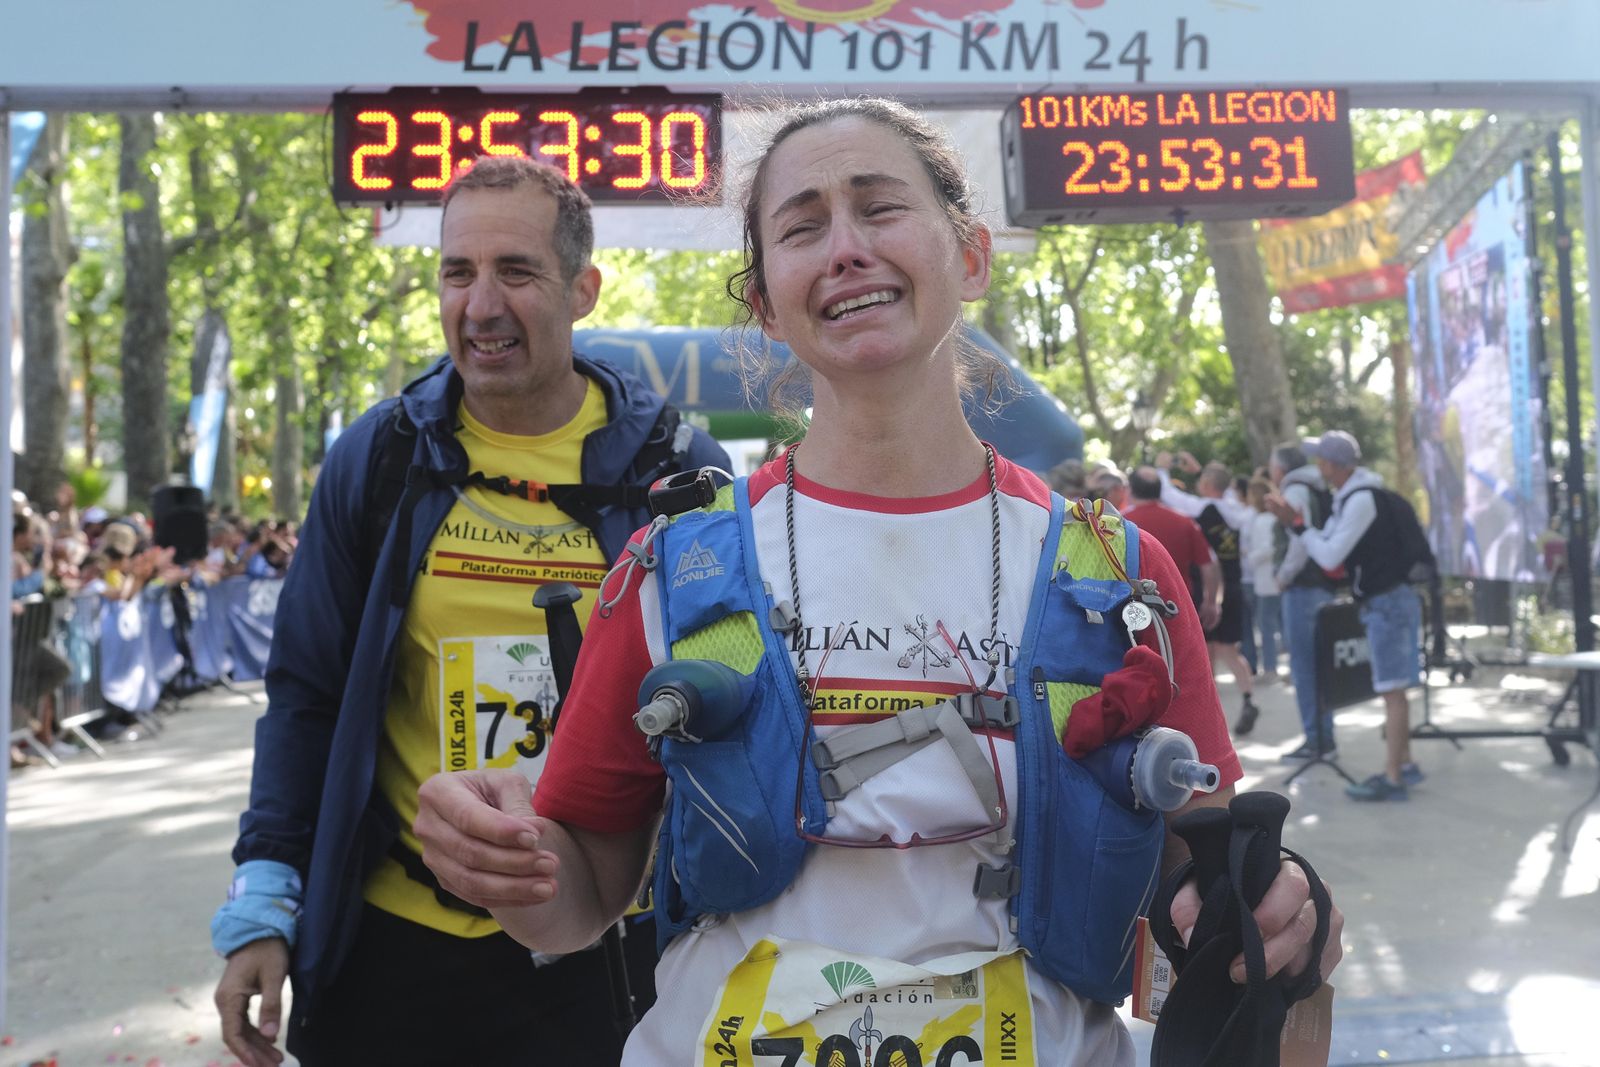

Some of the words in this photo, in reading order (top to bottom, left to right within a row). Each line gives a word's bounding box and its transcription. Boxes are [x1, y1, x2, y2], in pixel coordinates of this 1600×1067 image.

[463, 20, 544, 72] LA
[568, 7, 817, 72] LEGIÓN
[840, 29, 933, 72] 101
[958, 20, 1061, 71] KM
[1083, 29, 1152, 83] 24
[1174, 18, 1209, 71] h
[1020, 95, 1149, 128] 101KMs
[1157, 93, 1200, 125] LA
[1208, 90, 1337, 123] LEGION
[352, 111, 705, 189] 23:53:30
[1063, 136, 1318, 194] 23:53:31
[461, 561, 537, 577] Plataforma
[672, 566, 725, 590] AONIJIE
[953, 631, 1020, 668] AST
[813, 693, 923, 711] ataforma
[476, 700, 560, 759] 73
[1001, 1011, 1017, 1060] XXIII
